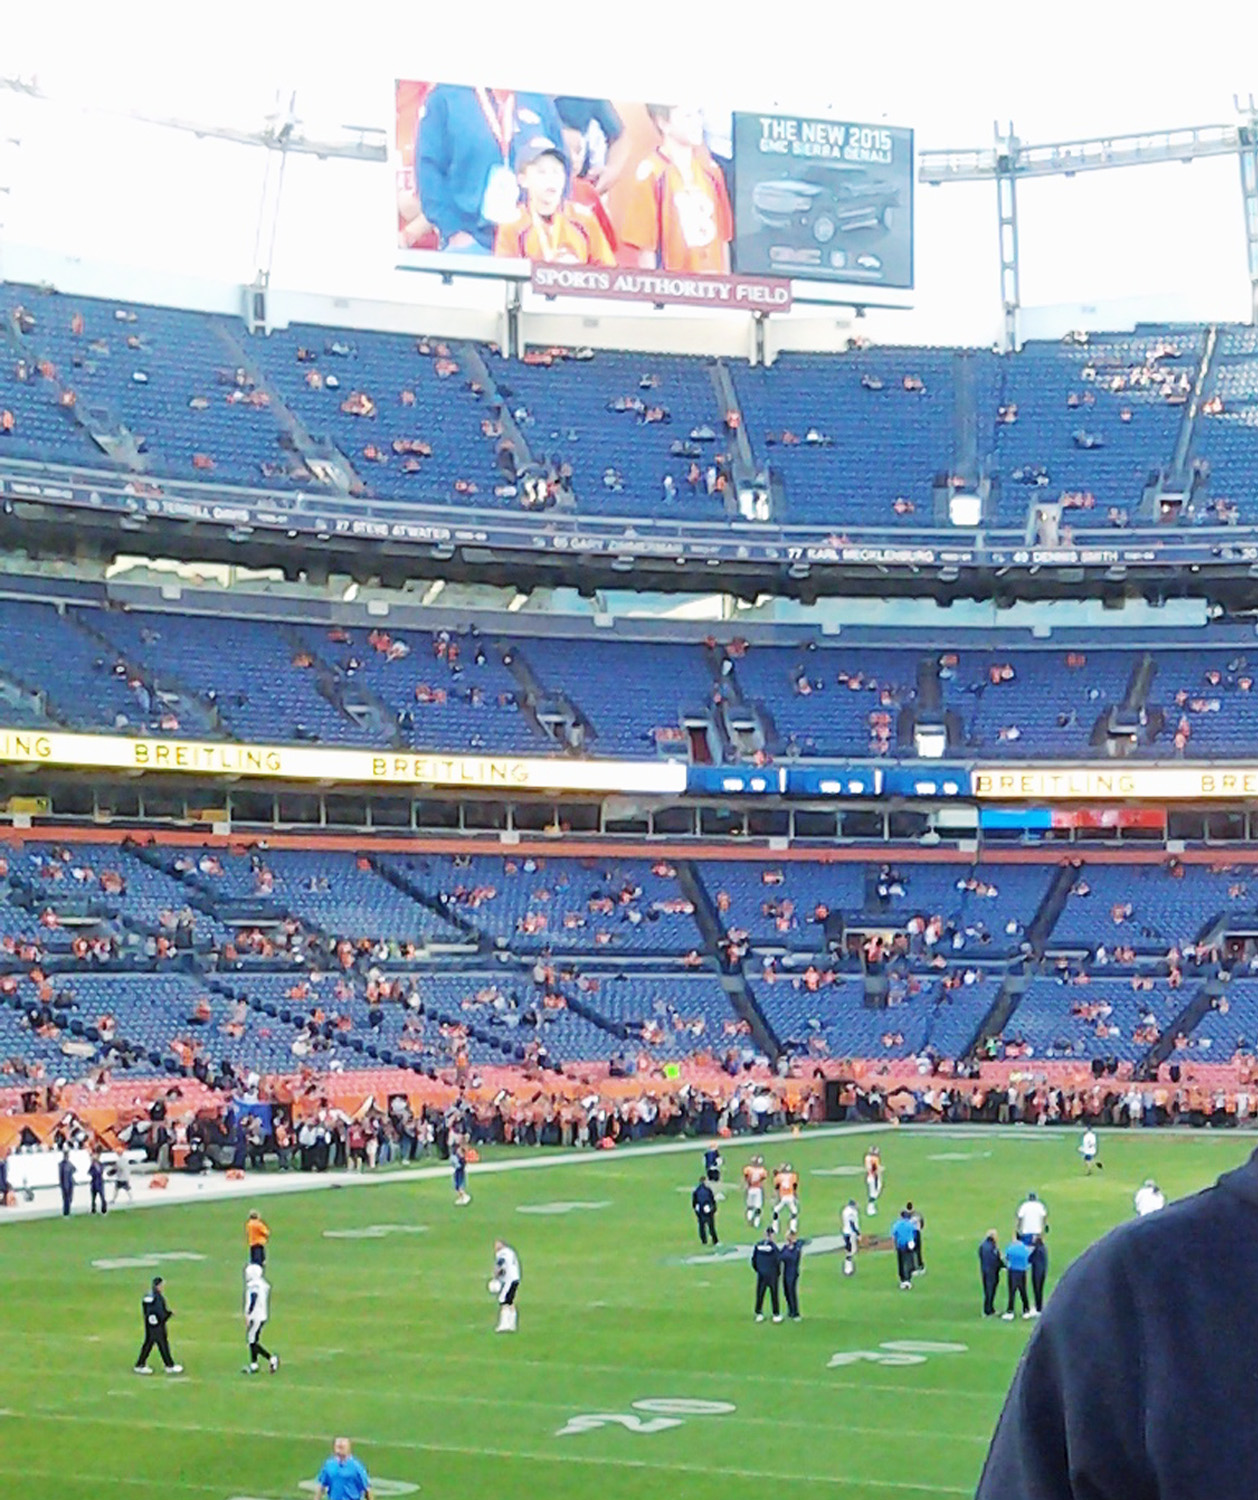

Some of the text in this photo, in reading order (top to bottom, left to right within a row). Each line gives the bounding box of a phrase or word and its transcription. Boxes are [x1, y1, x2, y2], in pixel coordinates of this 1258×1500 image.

[760, 118, 892, 150] THE NEW 2015
[535, 268, 788, 304] SPORTS AUTHORITY FIELD
[134, 743, 282, 771] BREITLING
[372, 757, 529, 783] BREITLING
[978, 774, 1135, 793] BREITLING
[555, 1398, 737, 1437] 20
